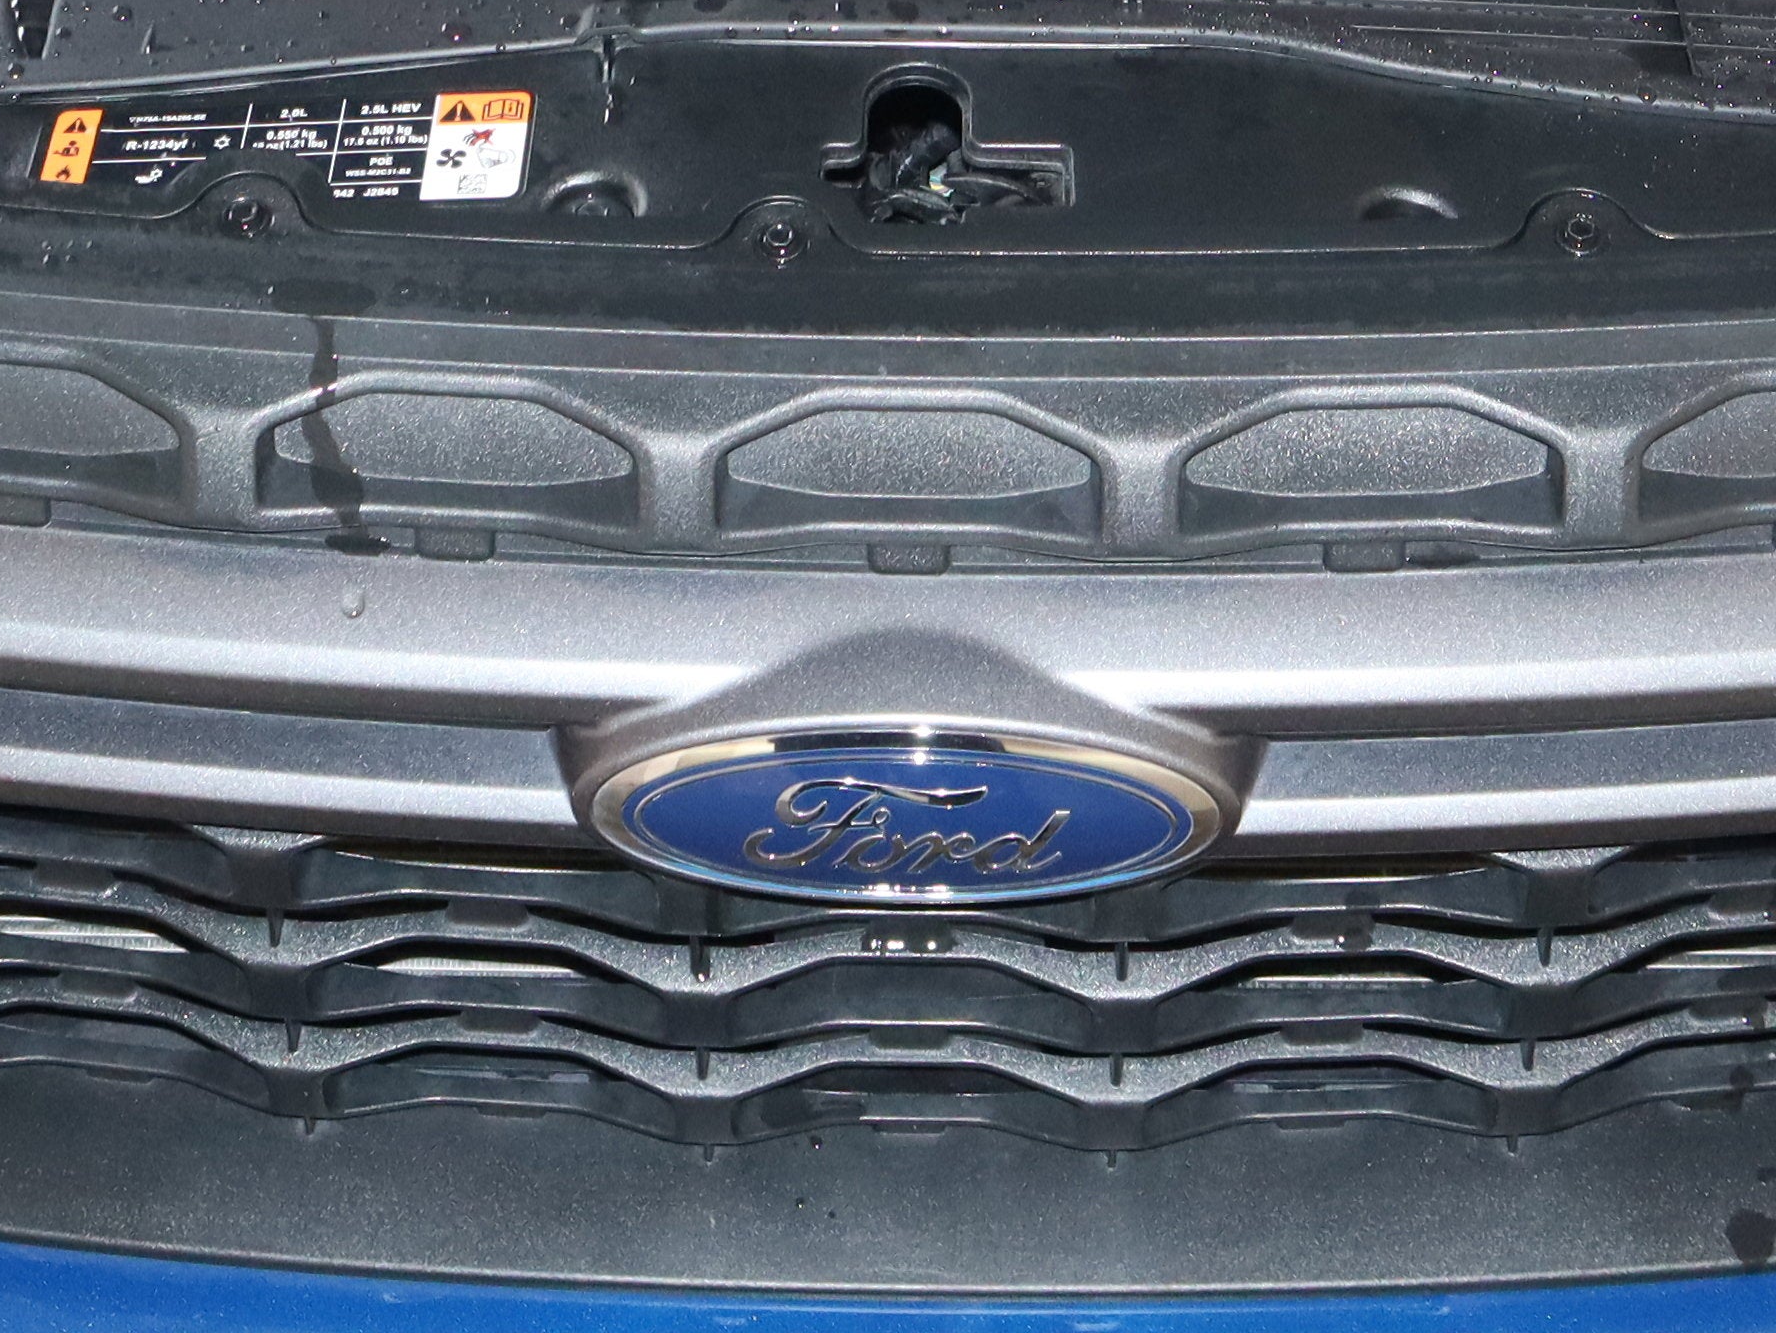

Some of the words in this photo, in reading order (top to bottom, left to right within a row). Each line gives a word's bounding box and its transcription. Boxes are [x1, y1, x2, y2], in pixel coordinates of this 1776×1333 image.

[391, 103, 422, 114] HEV
[301, 128, 318, 140] kg
[396, 124, 413, 136] kg
[125, 138, 189, 152] R-1234yf
[366, 137, 379, 146] oz
[407, 134, 428, 145] lbs)
[369, 156, 394, 166] POE
[743, 776, 1072, 874] Ford
